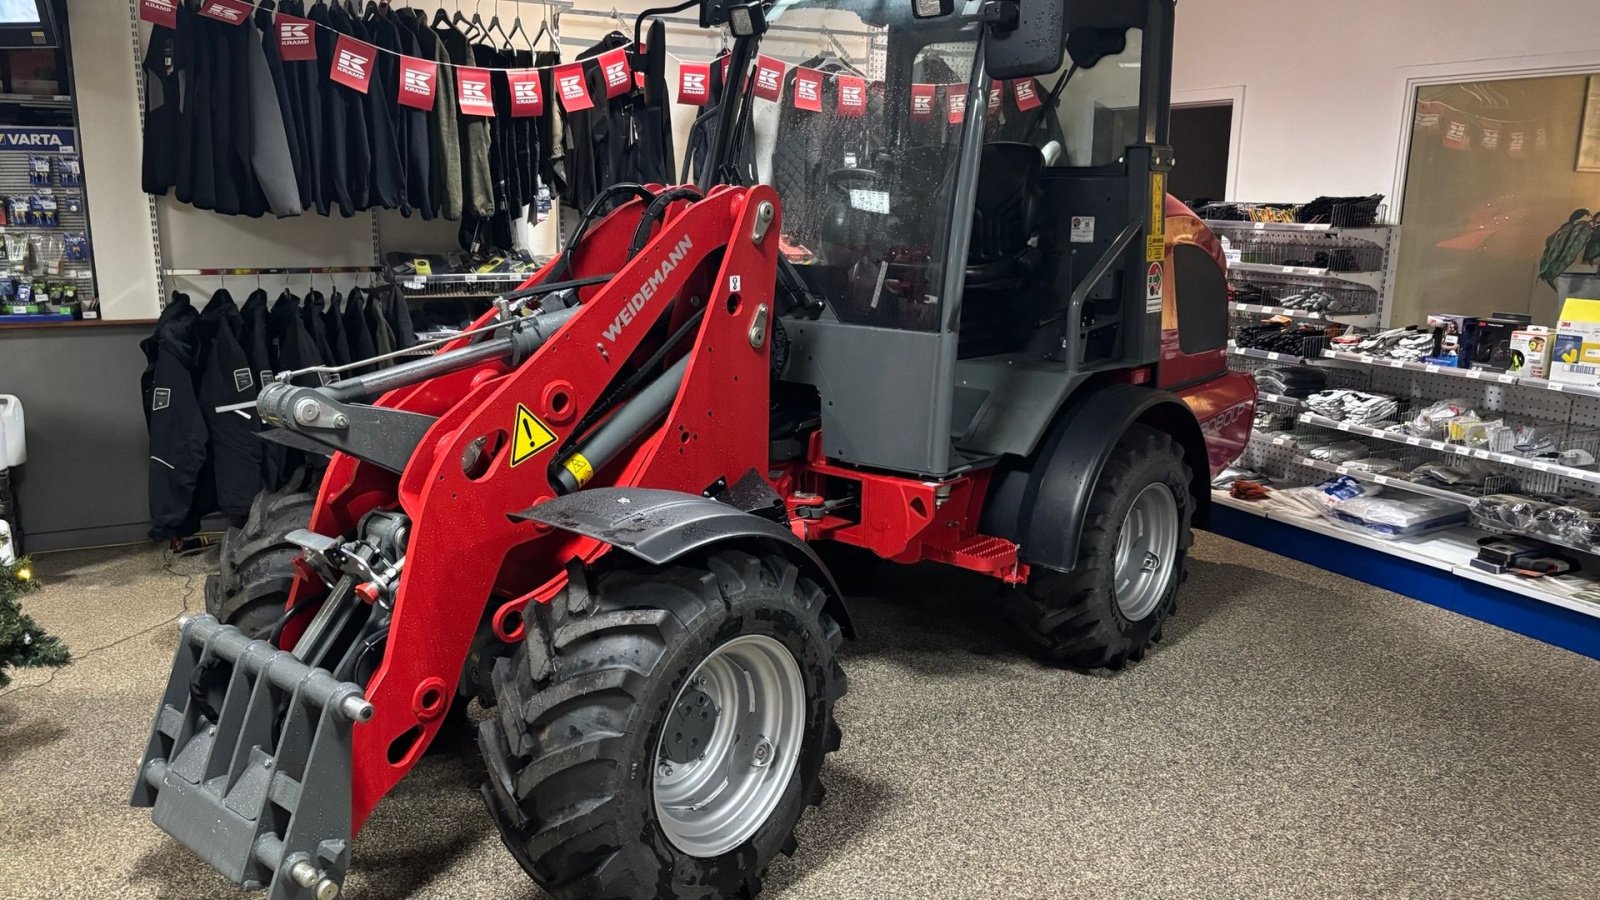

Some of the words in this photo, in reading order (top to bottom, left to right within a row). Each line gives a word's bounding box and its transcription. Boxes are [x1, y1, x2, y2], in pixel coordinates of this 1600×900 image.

[145, 2, 172, 12] KRAMP
[337, 67, 365, 80] KRAMP
[609, 78, 628, 88] KRAMP
[757, 82, 778, 91] KRAMP
[405, 86, 431, 96] KRAMP
[564, 92, 585, 100] KRAMP
[7, 133, 63, 146] VARTA
[602, 233, 693, 342] WEIDEMANN
